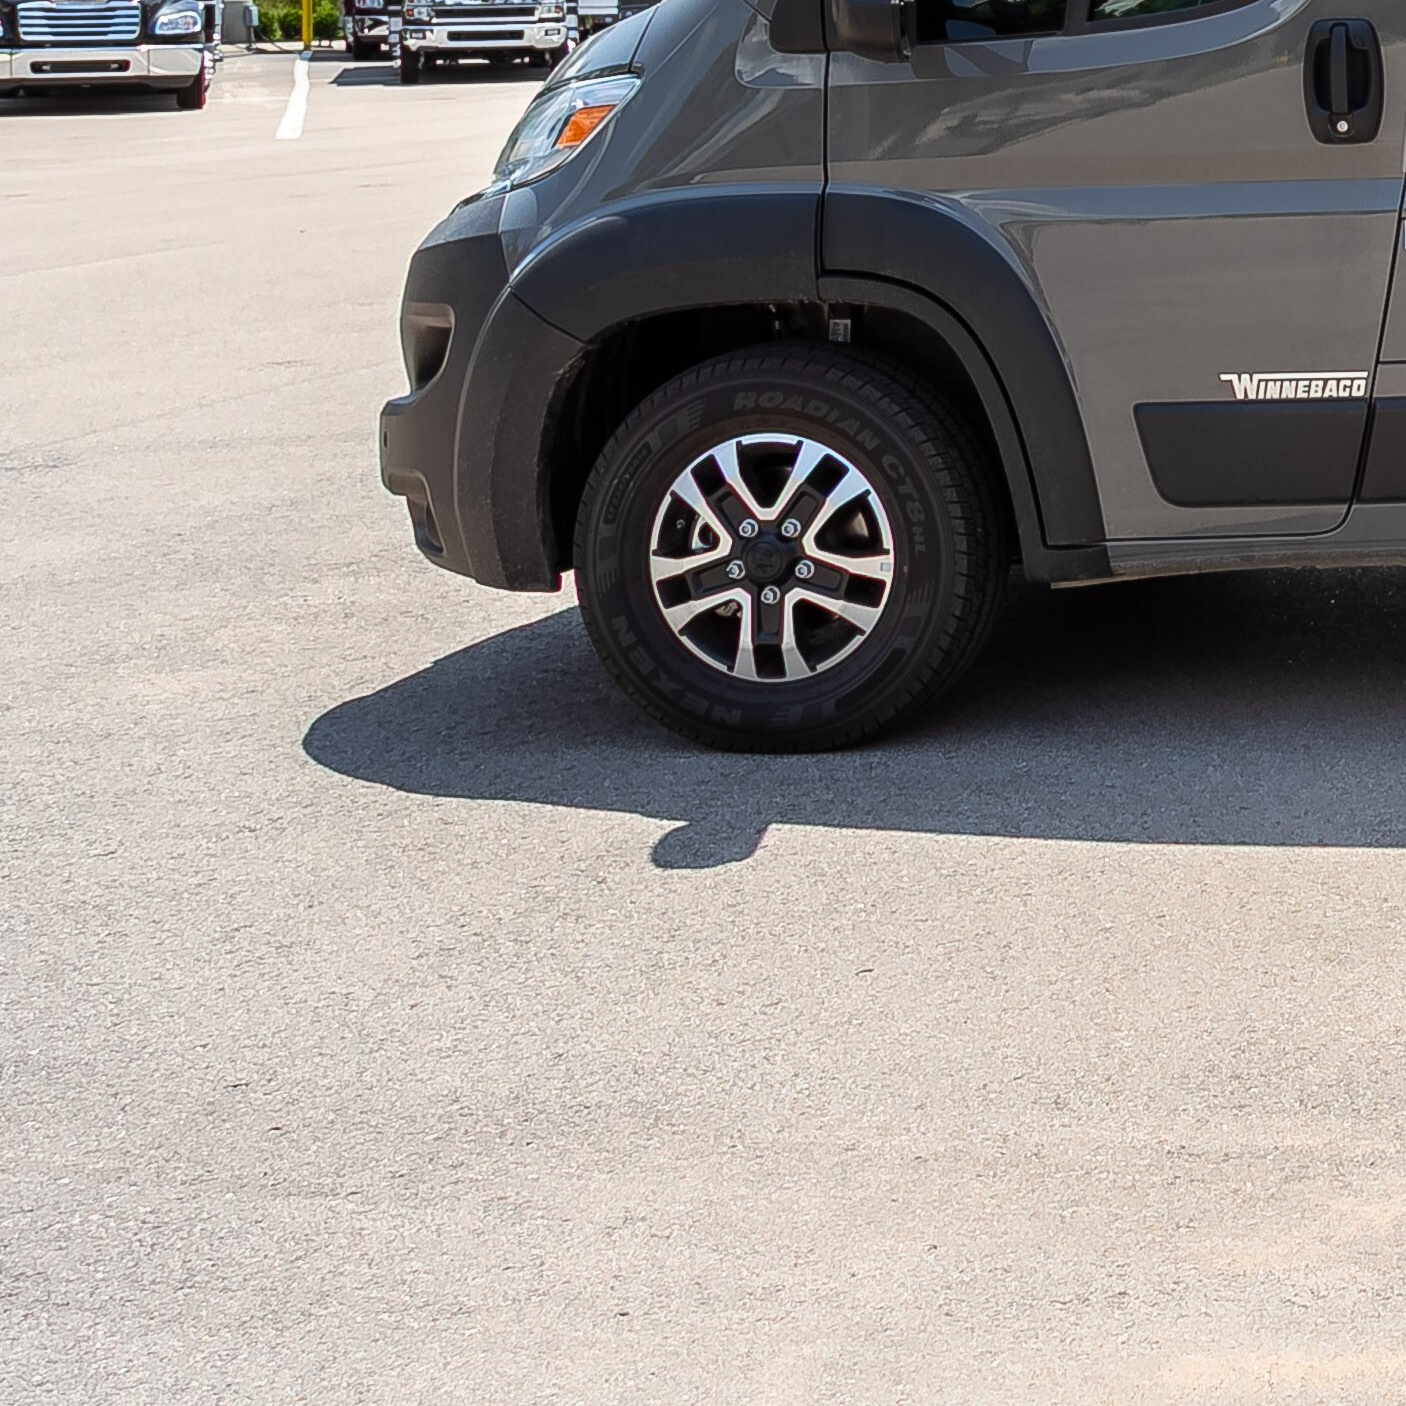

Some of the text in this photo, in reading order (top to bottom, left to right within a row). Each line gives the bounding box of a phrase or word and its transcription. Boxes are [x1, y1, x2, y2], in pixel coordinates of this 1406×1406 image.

[1219, 371, 1369, 400] WINNEBAGO
[732, 391, 880, 454] ROADIAN
[610, 616, 744, 727] NEXEN
